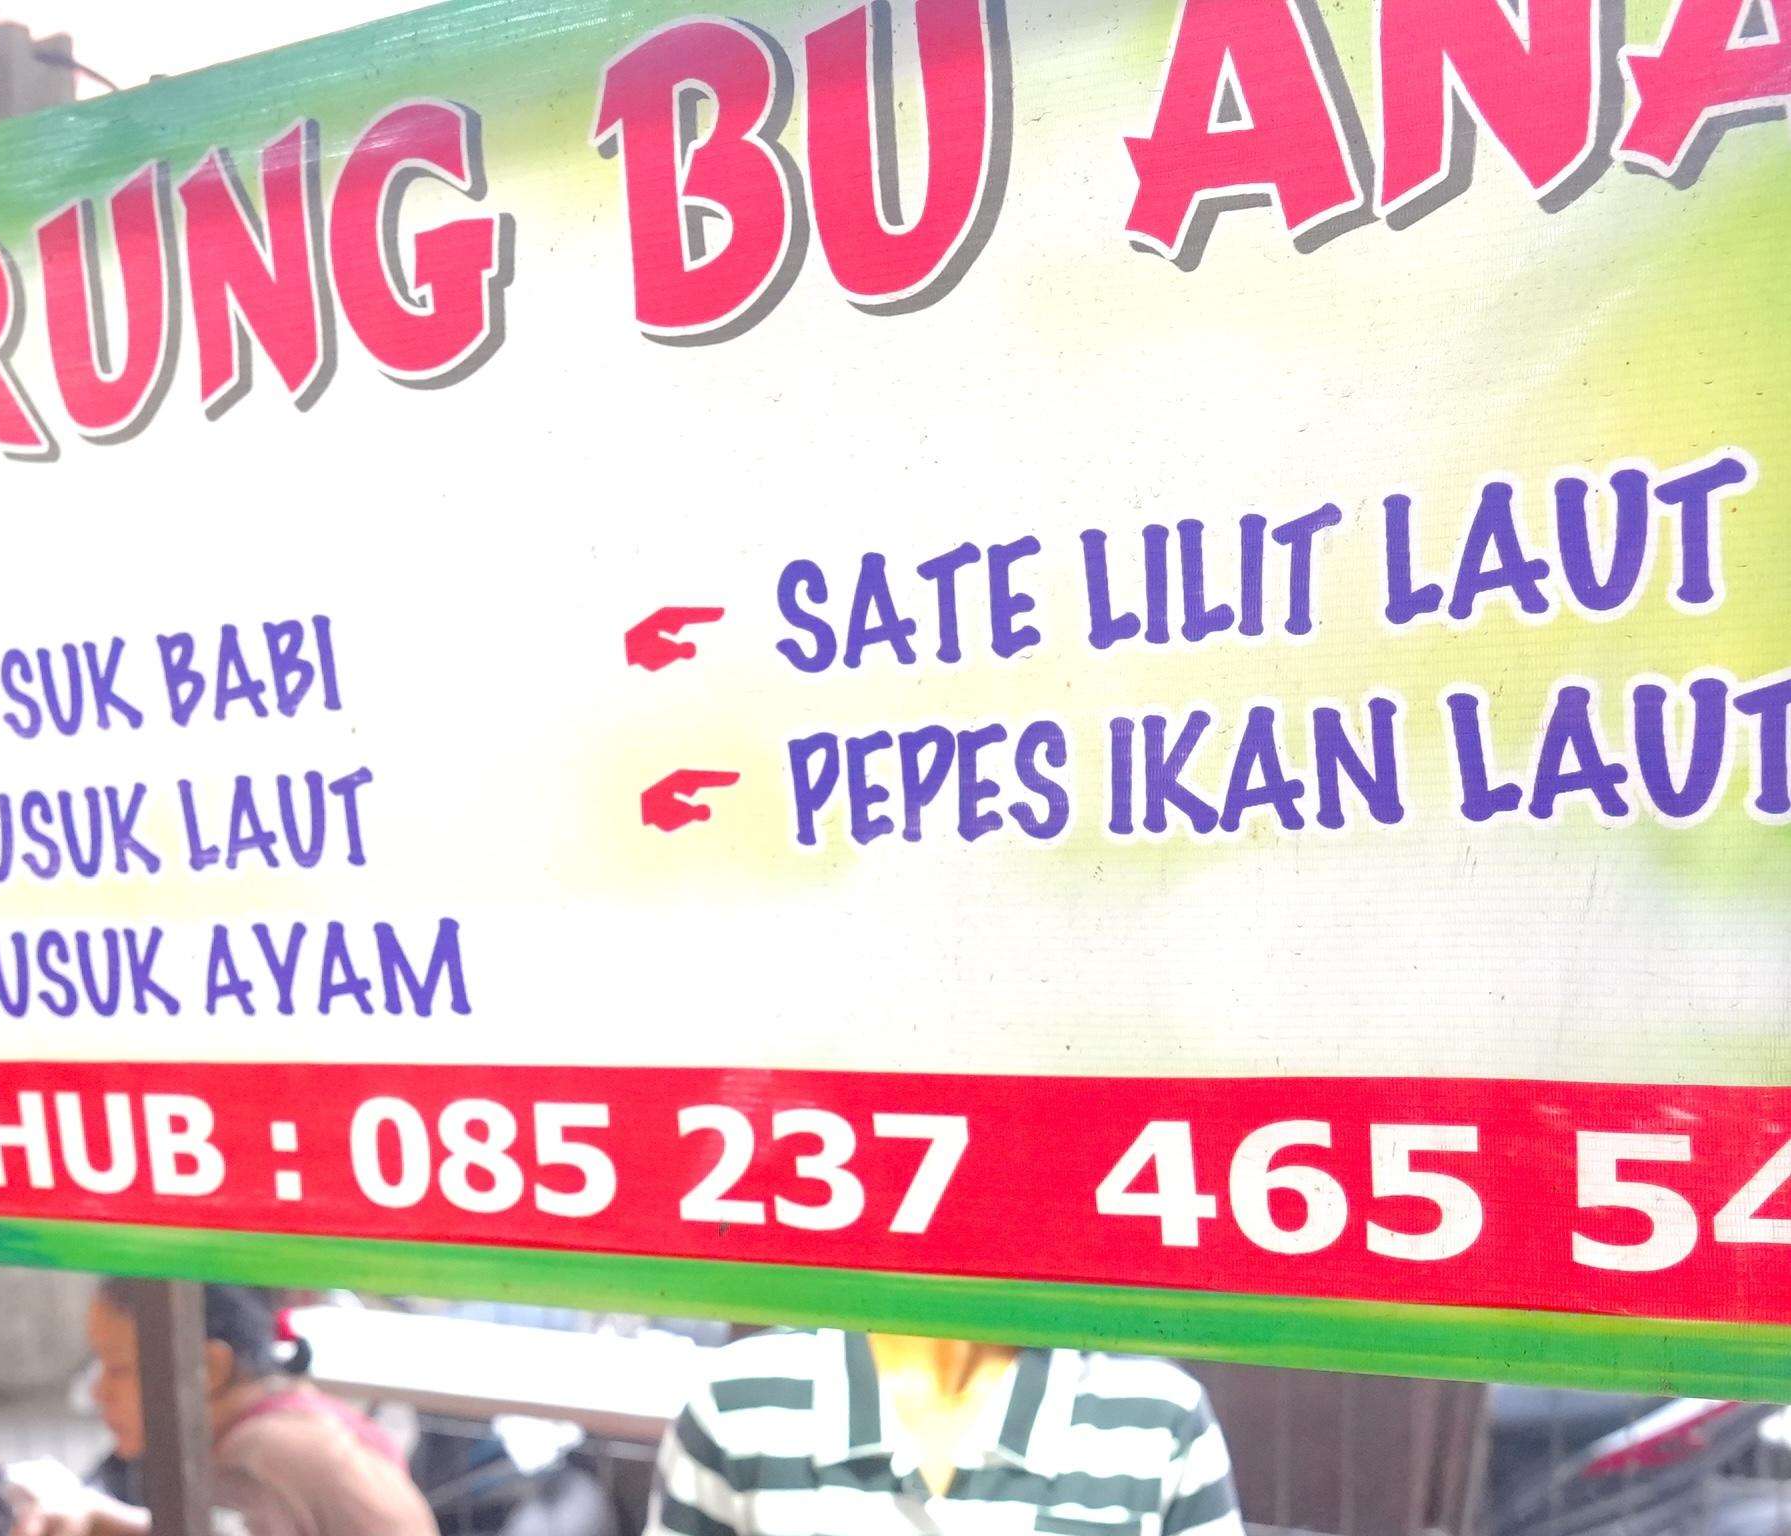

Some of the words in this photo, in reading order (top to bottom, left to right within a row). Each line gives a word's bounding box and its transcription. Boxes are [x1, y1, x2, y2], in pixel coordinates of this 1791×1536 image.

[594, 0, 1010, 344] BU
[775, 534, 1042, 673] SATE
[1079, 501, 1342, 651] LILIT
[1382, 457, 1748, 626] LAUT
[156, 614, 342, 727] BABI
[178, 766, 373, 872] LAUT
[788, 719, 1070, 847] PEPES
[1108, 696, 1405, 836] IKAN
[1446, 677, 1791, 823] LAUT
[205, 916, 473, 1019] AYAM
[349, 1095, 618, 1219] 085
[676, 1103, 970, 1235] 237
[1094, 1118, 1485, 1262] 465
